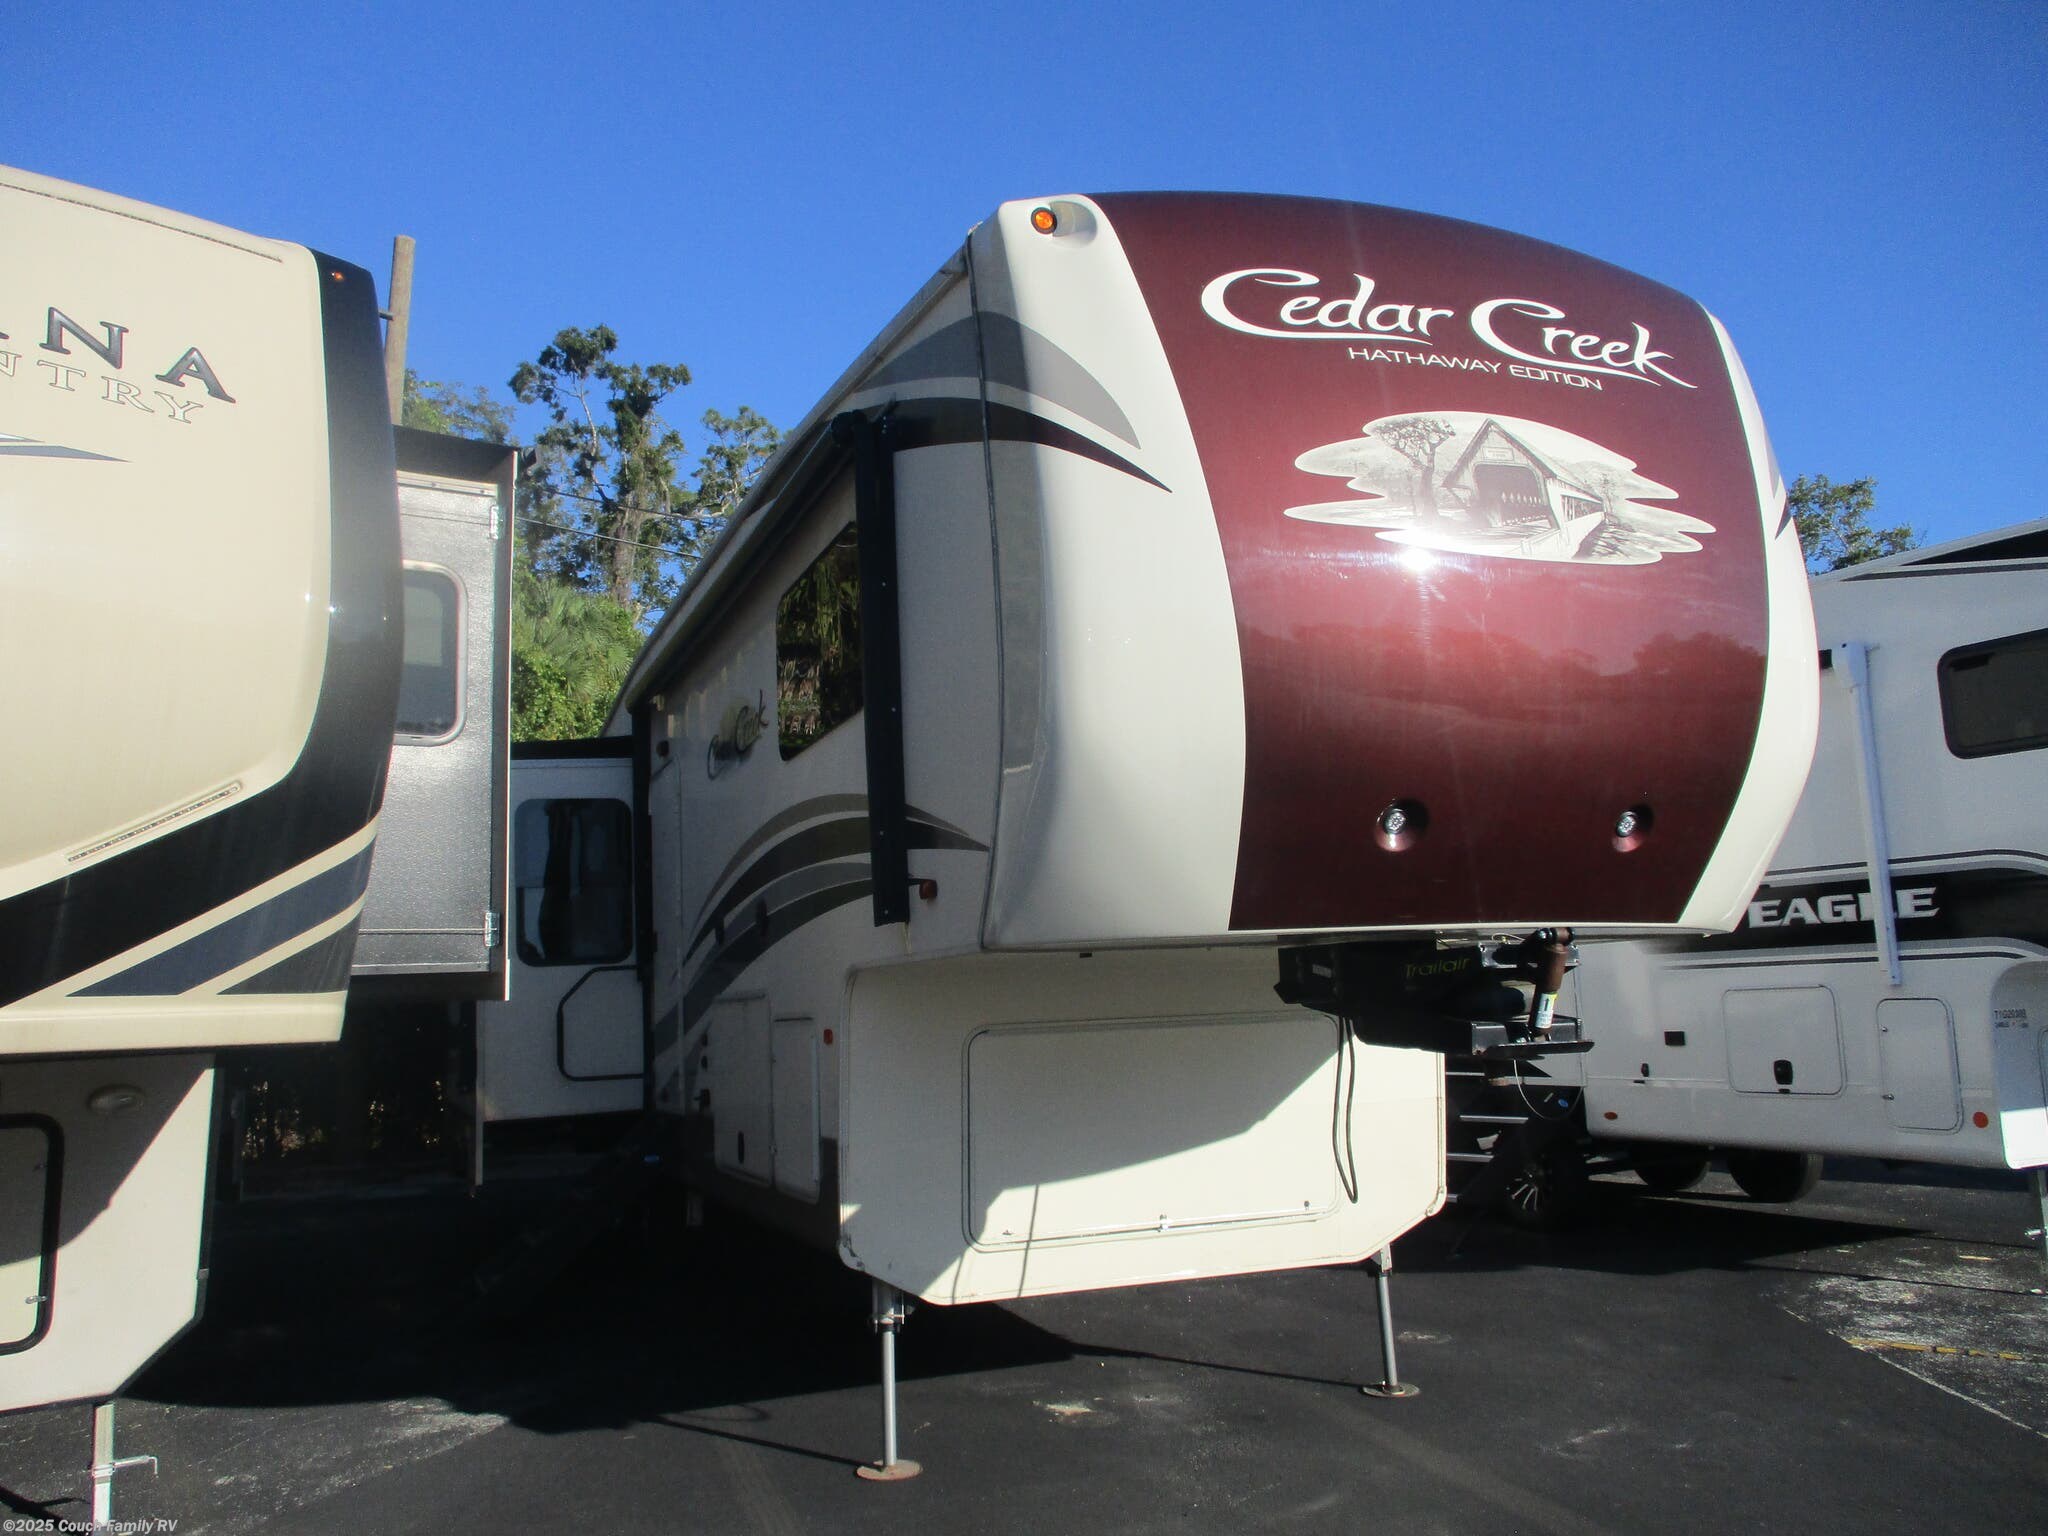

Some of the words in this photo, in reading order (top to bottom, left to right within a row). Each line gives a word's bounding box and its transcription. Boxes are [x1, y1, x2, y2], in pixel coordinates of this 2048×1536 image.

[0, 306, 236, 404] NA
[1201, 268, 1454, 345] Cedar
[1471, 298, 1698, 389] Creek
[1348, 347, 1502, 374] HATHAWAY
[1509, 364, 1603, 391] EDITION
